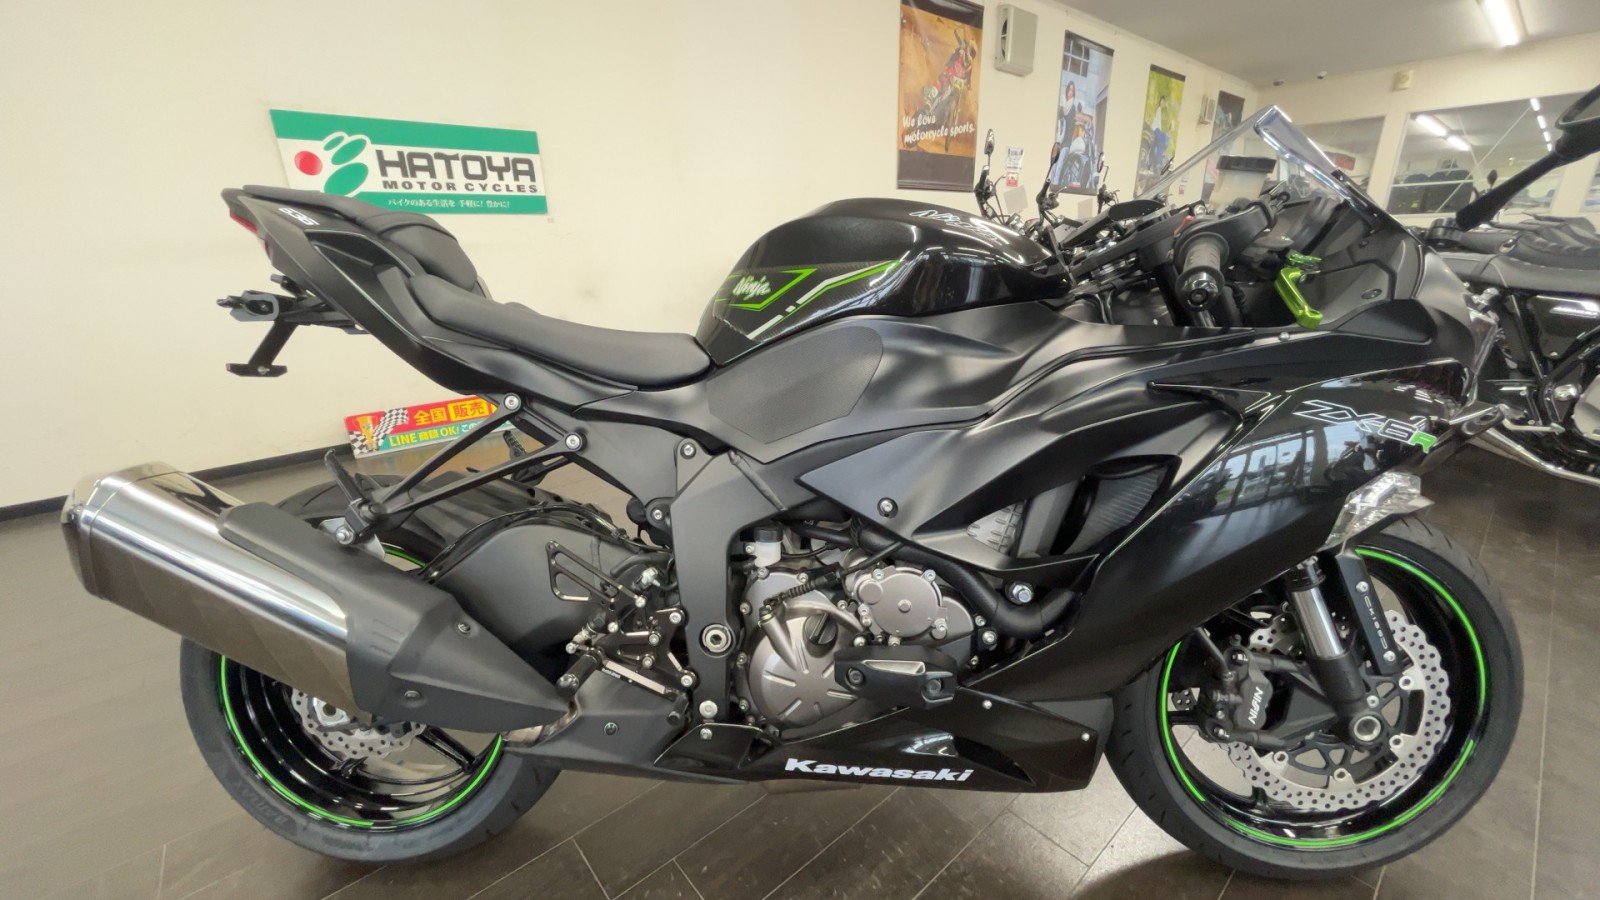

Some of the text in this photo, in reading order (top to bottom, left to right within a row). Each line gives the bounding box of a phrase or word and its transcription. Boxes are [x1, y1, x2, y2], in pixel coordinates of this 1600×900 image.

[902, 113, 937, 129] We love
[904, 125, 949, 144] motorcycle
[375, 149, 537, 183] HATOYA
[382, 180, 538, 193] MOTOR CYCLES
[732, 274, 772, 301] Ninja
[414, 402, 486, 426] 全国 販売
[388, 433, 417, 447] LINE
[784, 758, 974, 782] Kawasaki
